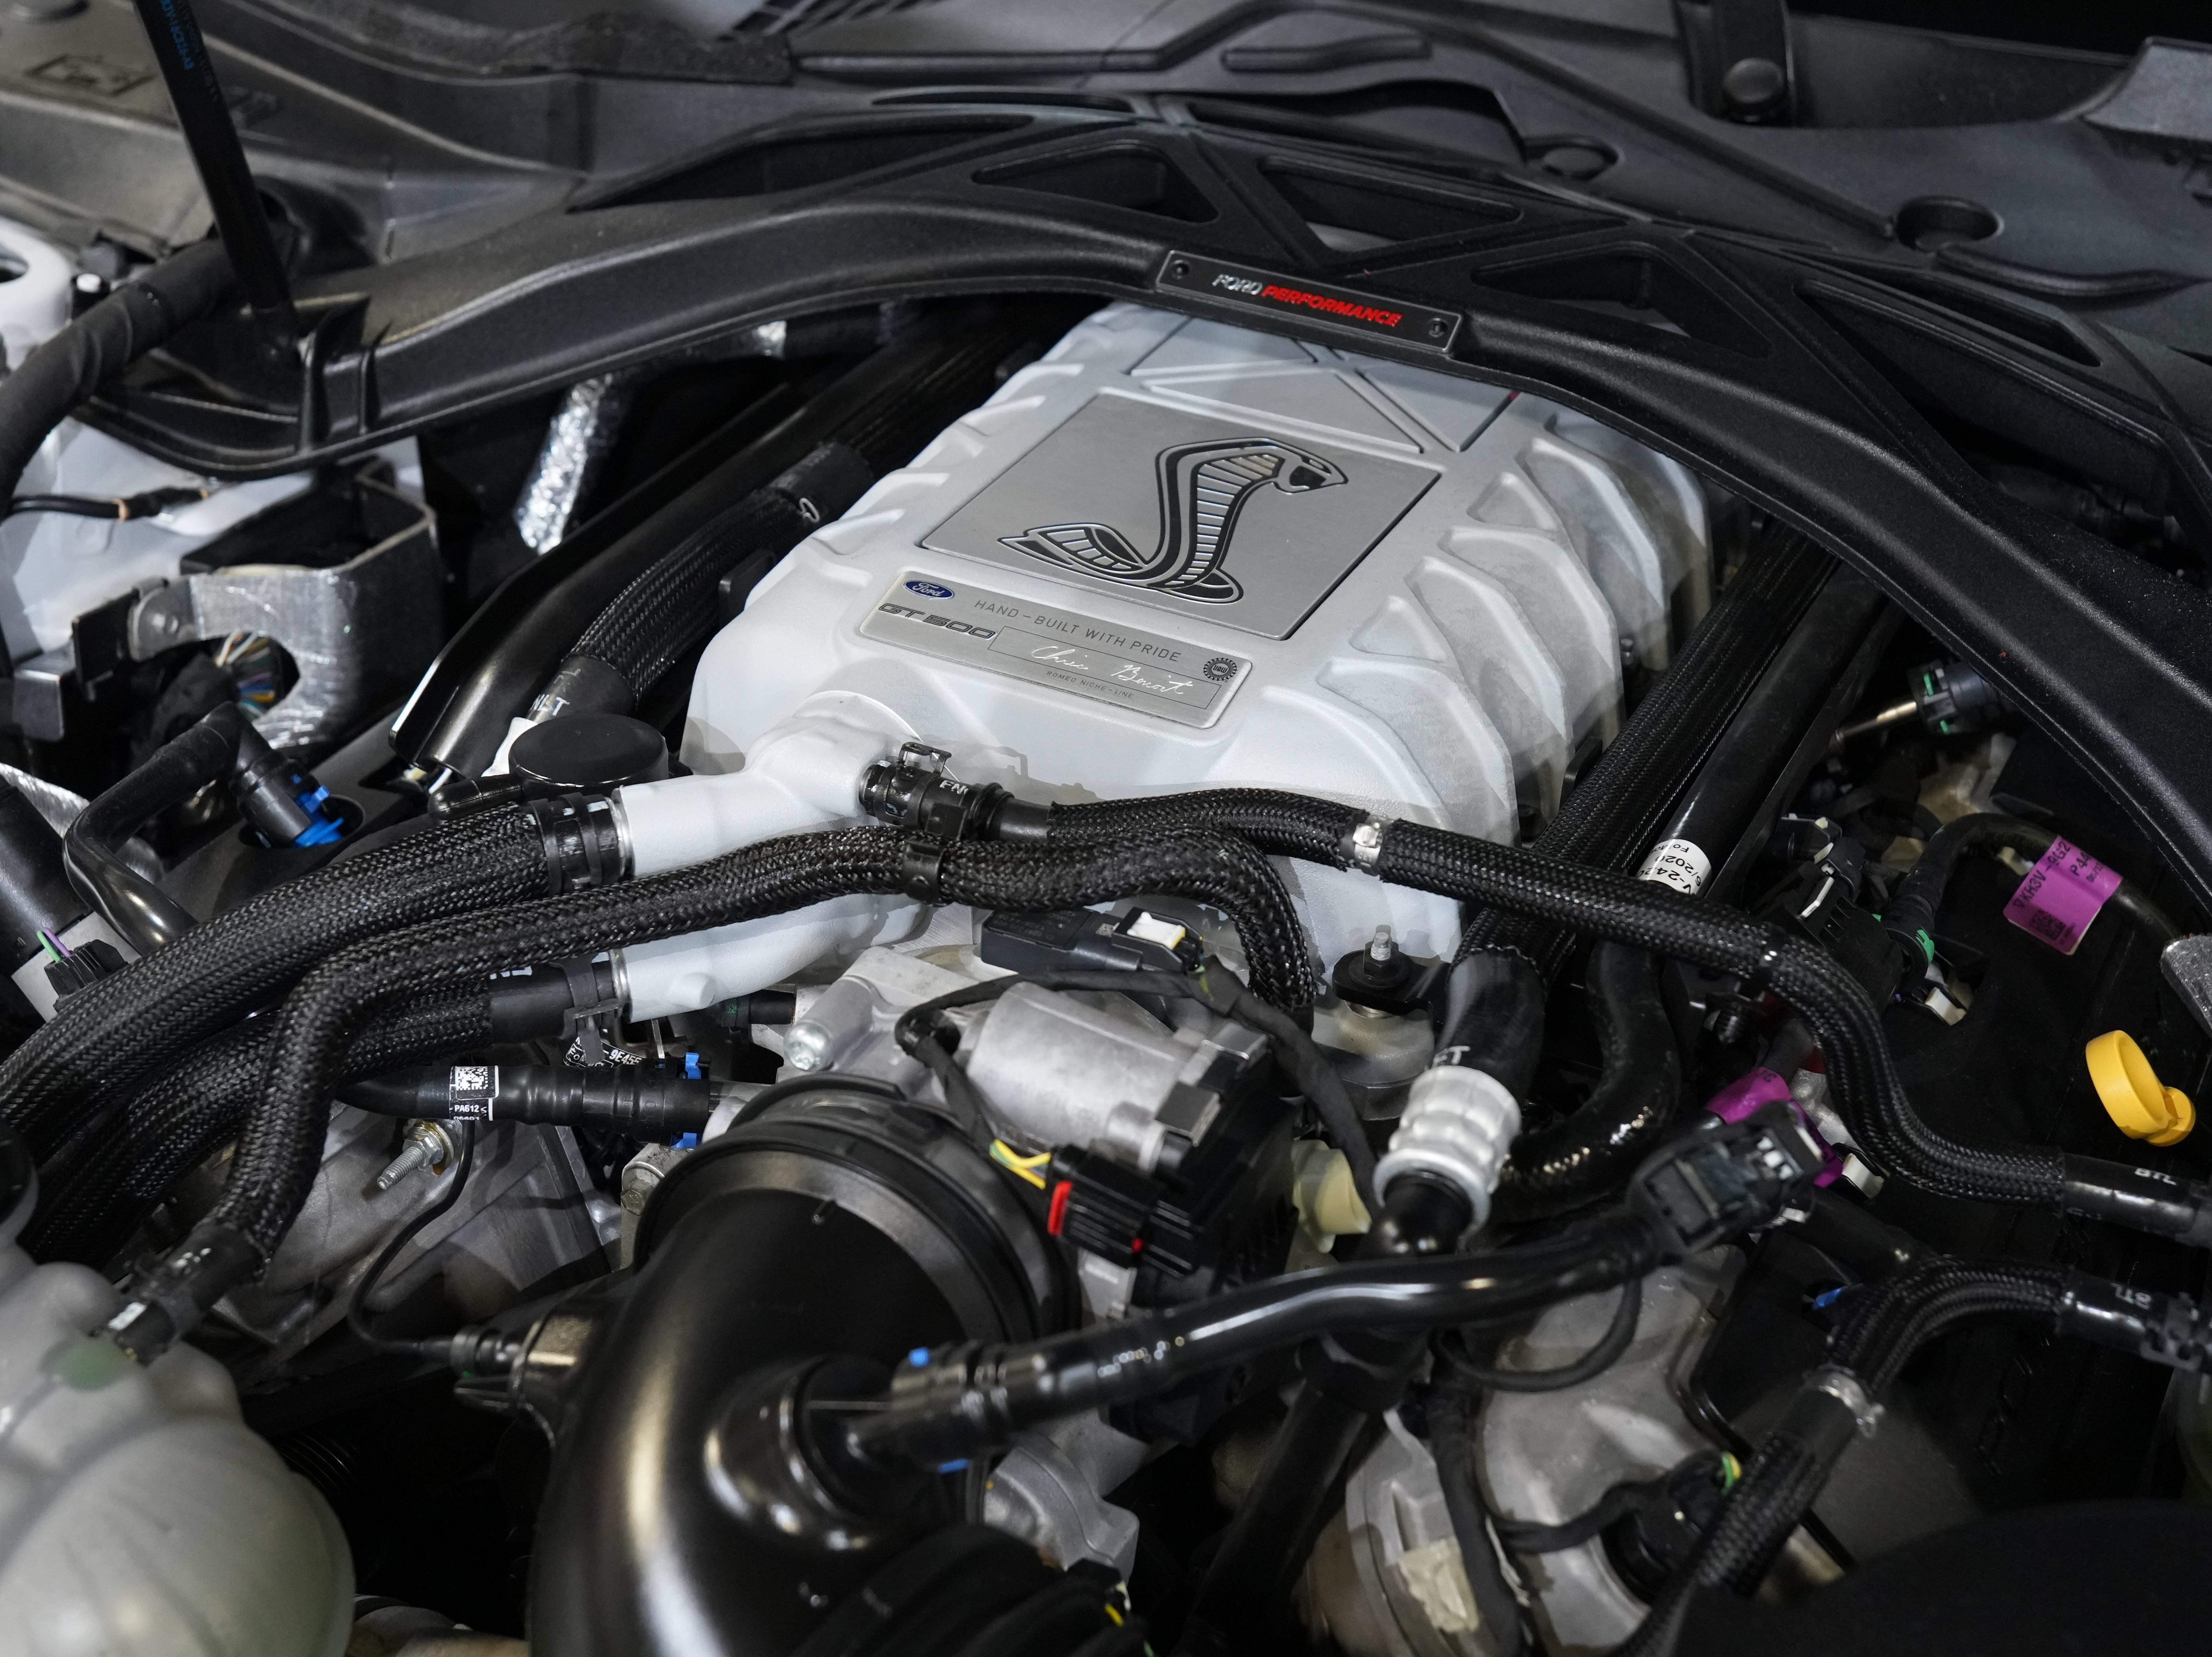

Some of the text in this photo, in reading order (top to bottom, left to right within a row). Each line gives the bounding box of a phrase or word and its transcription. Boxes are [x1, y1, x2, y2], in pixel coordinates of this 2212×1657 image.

[1212, 274, 1403, 327] FORD PERFORMANCE
[912, 582, 945, 597] Ford
[1085, 628, 1126, 647] WITH
[1130, 640, 1182, 662] PRIDE
[1031, 646, 1088, 670] Chris
[1212, 664, 1229, 673] UAW
[1046, 670, 1077, 683] ROMEO
[454, 1104, 479, 1113] PA612
